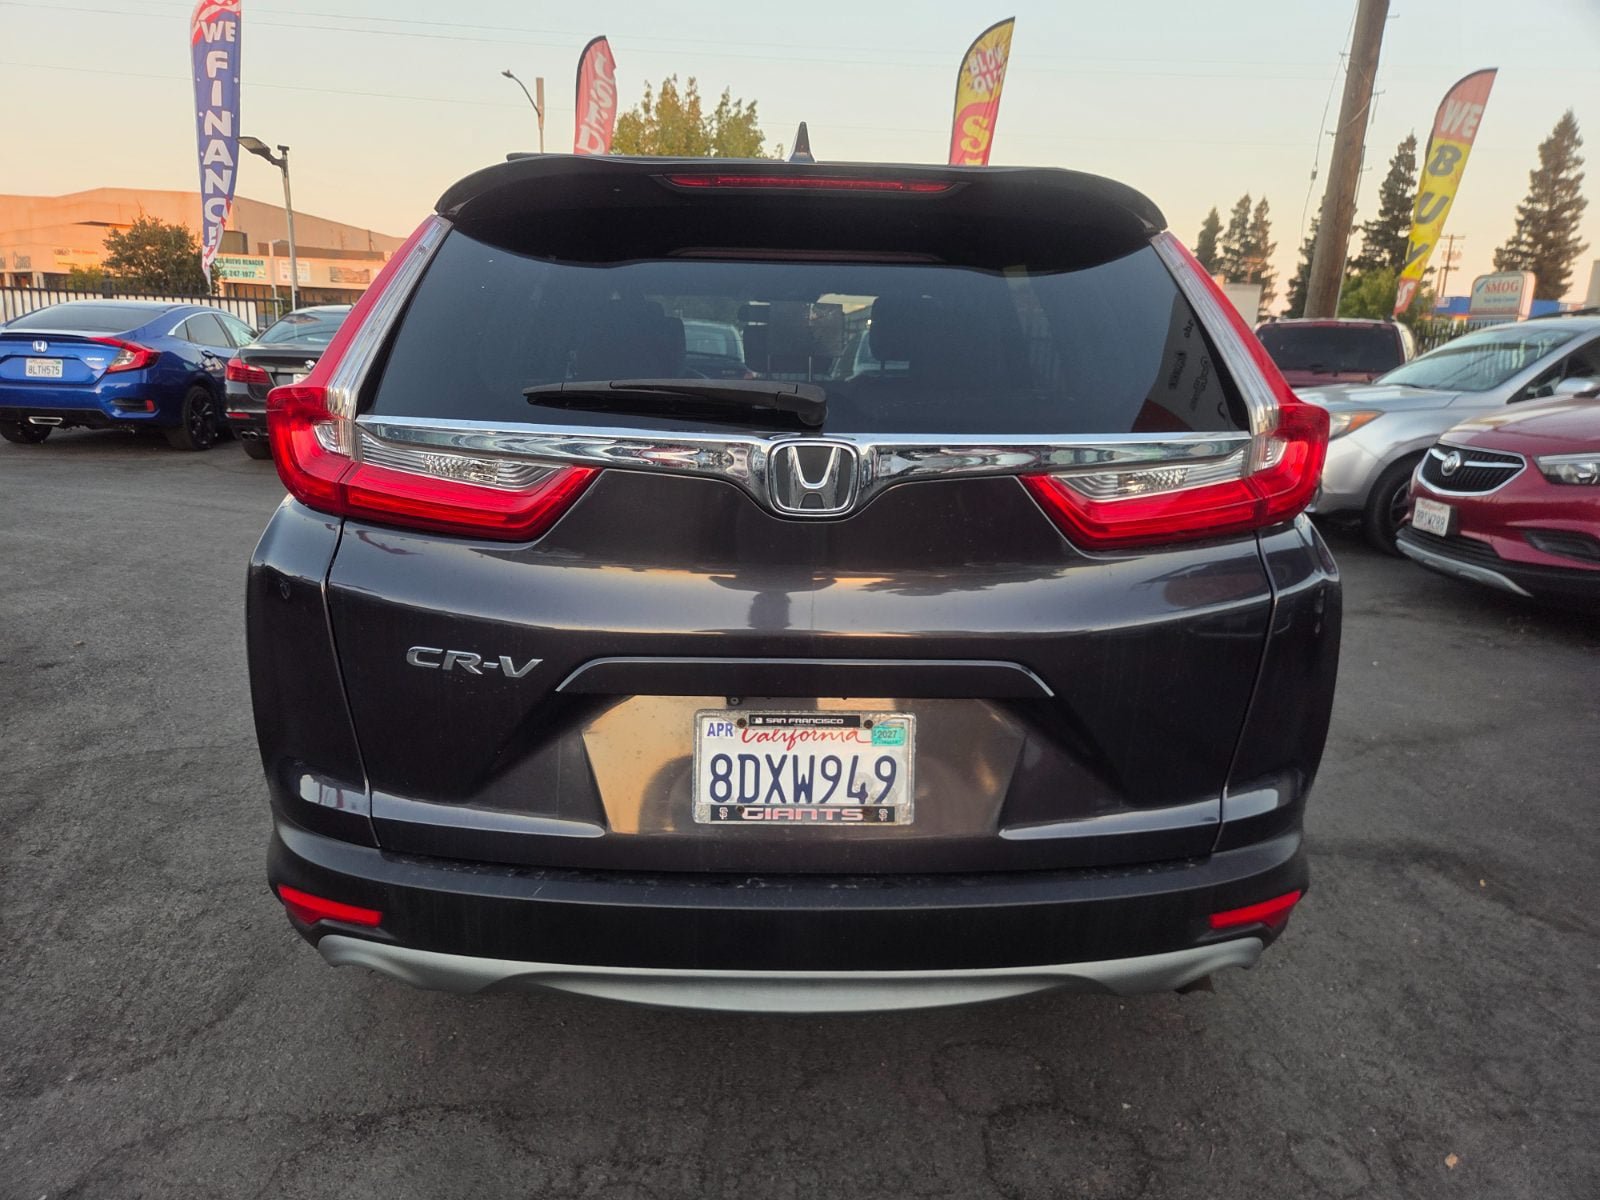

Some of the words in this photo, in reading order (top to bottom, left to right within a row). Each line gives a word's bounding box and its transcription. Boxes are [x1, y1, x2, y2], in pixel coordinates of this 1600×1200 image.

[200, 20, 236, 43] WE
[1440, 101, 1484, 138] WE
[1406, 144, 1462, 265] BUY
[1485, 281, 1518, 294] SMOG
[406, 646, 544, 678] CR-V
[706, 722, 734, 737] APR
[741, 727, 872, 751] California
[877, 730, 898, 739] 2027
[709, 753, 897, 805] 8DXW949
[741, 806, 864, 821] GIANTS
